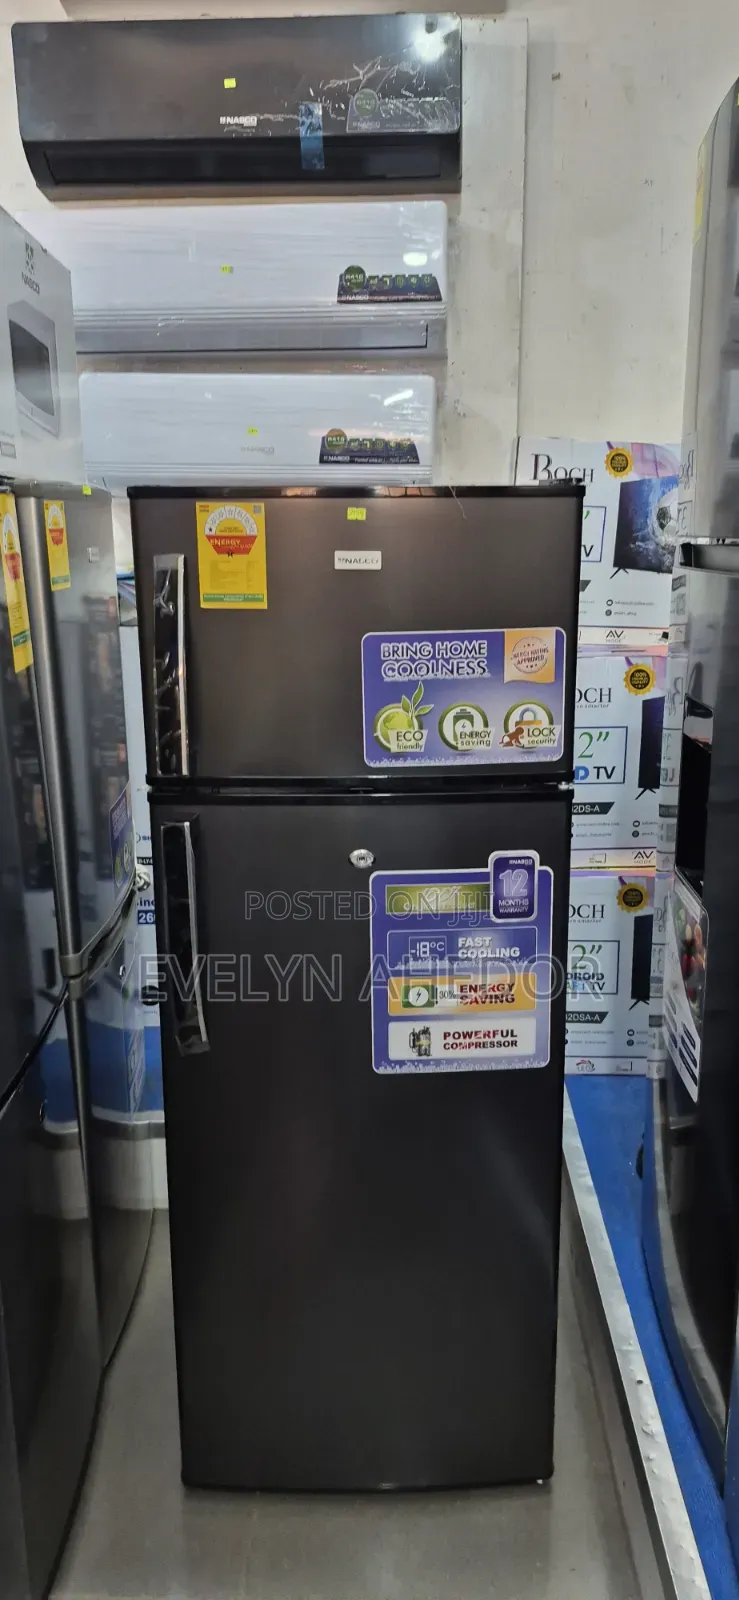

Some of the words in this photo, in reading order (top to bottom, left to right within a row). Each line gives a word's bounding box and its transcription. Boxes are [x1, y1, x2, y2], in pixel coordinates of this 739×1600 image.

[531, 453, 595, 483] BOCH
[210, 537, 241, 547] ENERGY
[381, 642, 432, 659] BRING
[436, 640, 488, 657] HOME
[382, 660, 488, 678] COOLNESS
[396, 731, 424, 742] ECO
[460, 730, 491, 739] ENERGY
[527, 727, 556, 738] LOCK
[396, 742, 424, 752] friendly
[460, 738, 491, 748] saving
[527, 737, 557, 746] security
[593, 765, 617, 780] TV
[572, 804, 601, 813] 2DS-A
[498, 868, 529, 898] 12
[498, 898, 530, 907] MONTHS
[458, 936, 492, 947] FAST
[458, 946, 521, 959] COOLING
[460, 983, 515, 994] ENERGY
[459, 993, 515, 1005] SAVING
[565, 1013, 601, 1022] 2DSA-A
[443, 1029, 518, 1041] POWERFUL
[443, 1040, 518, 1051] COMPRESSOR
